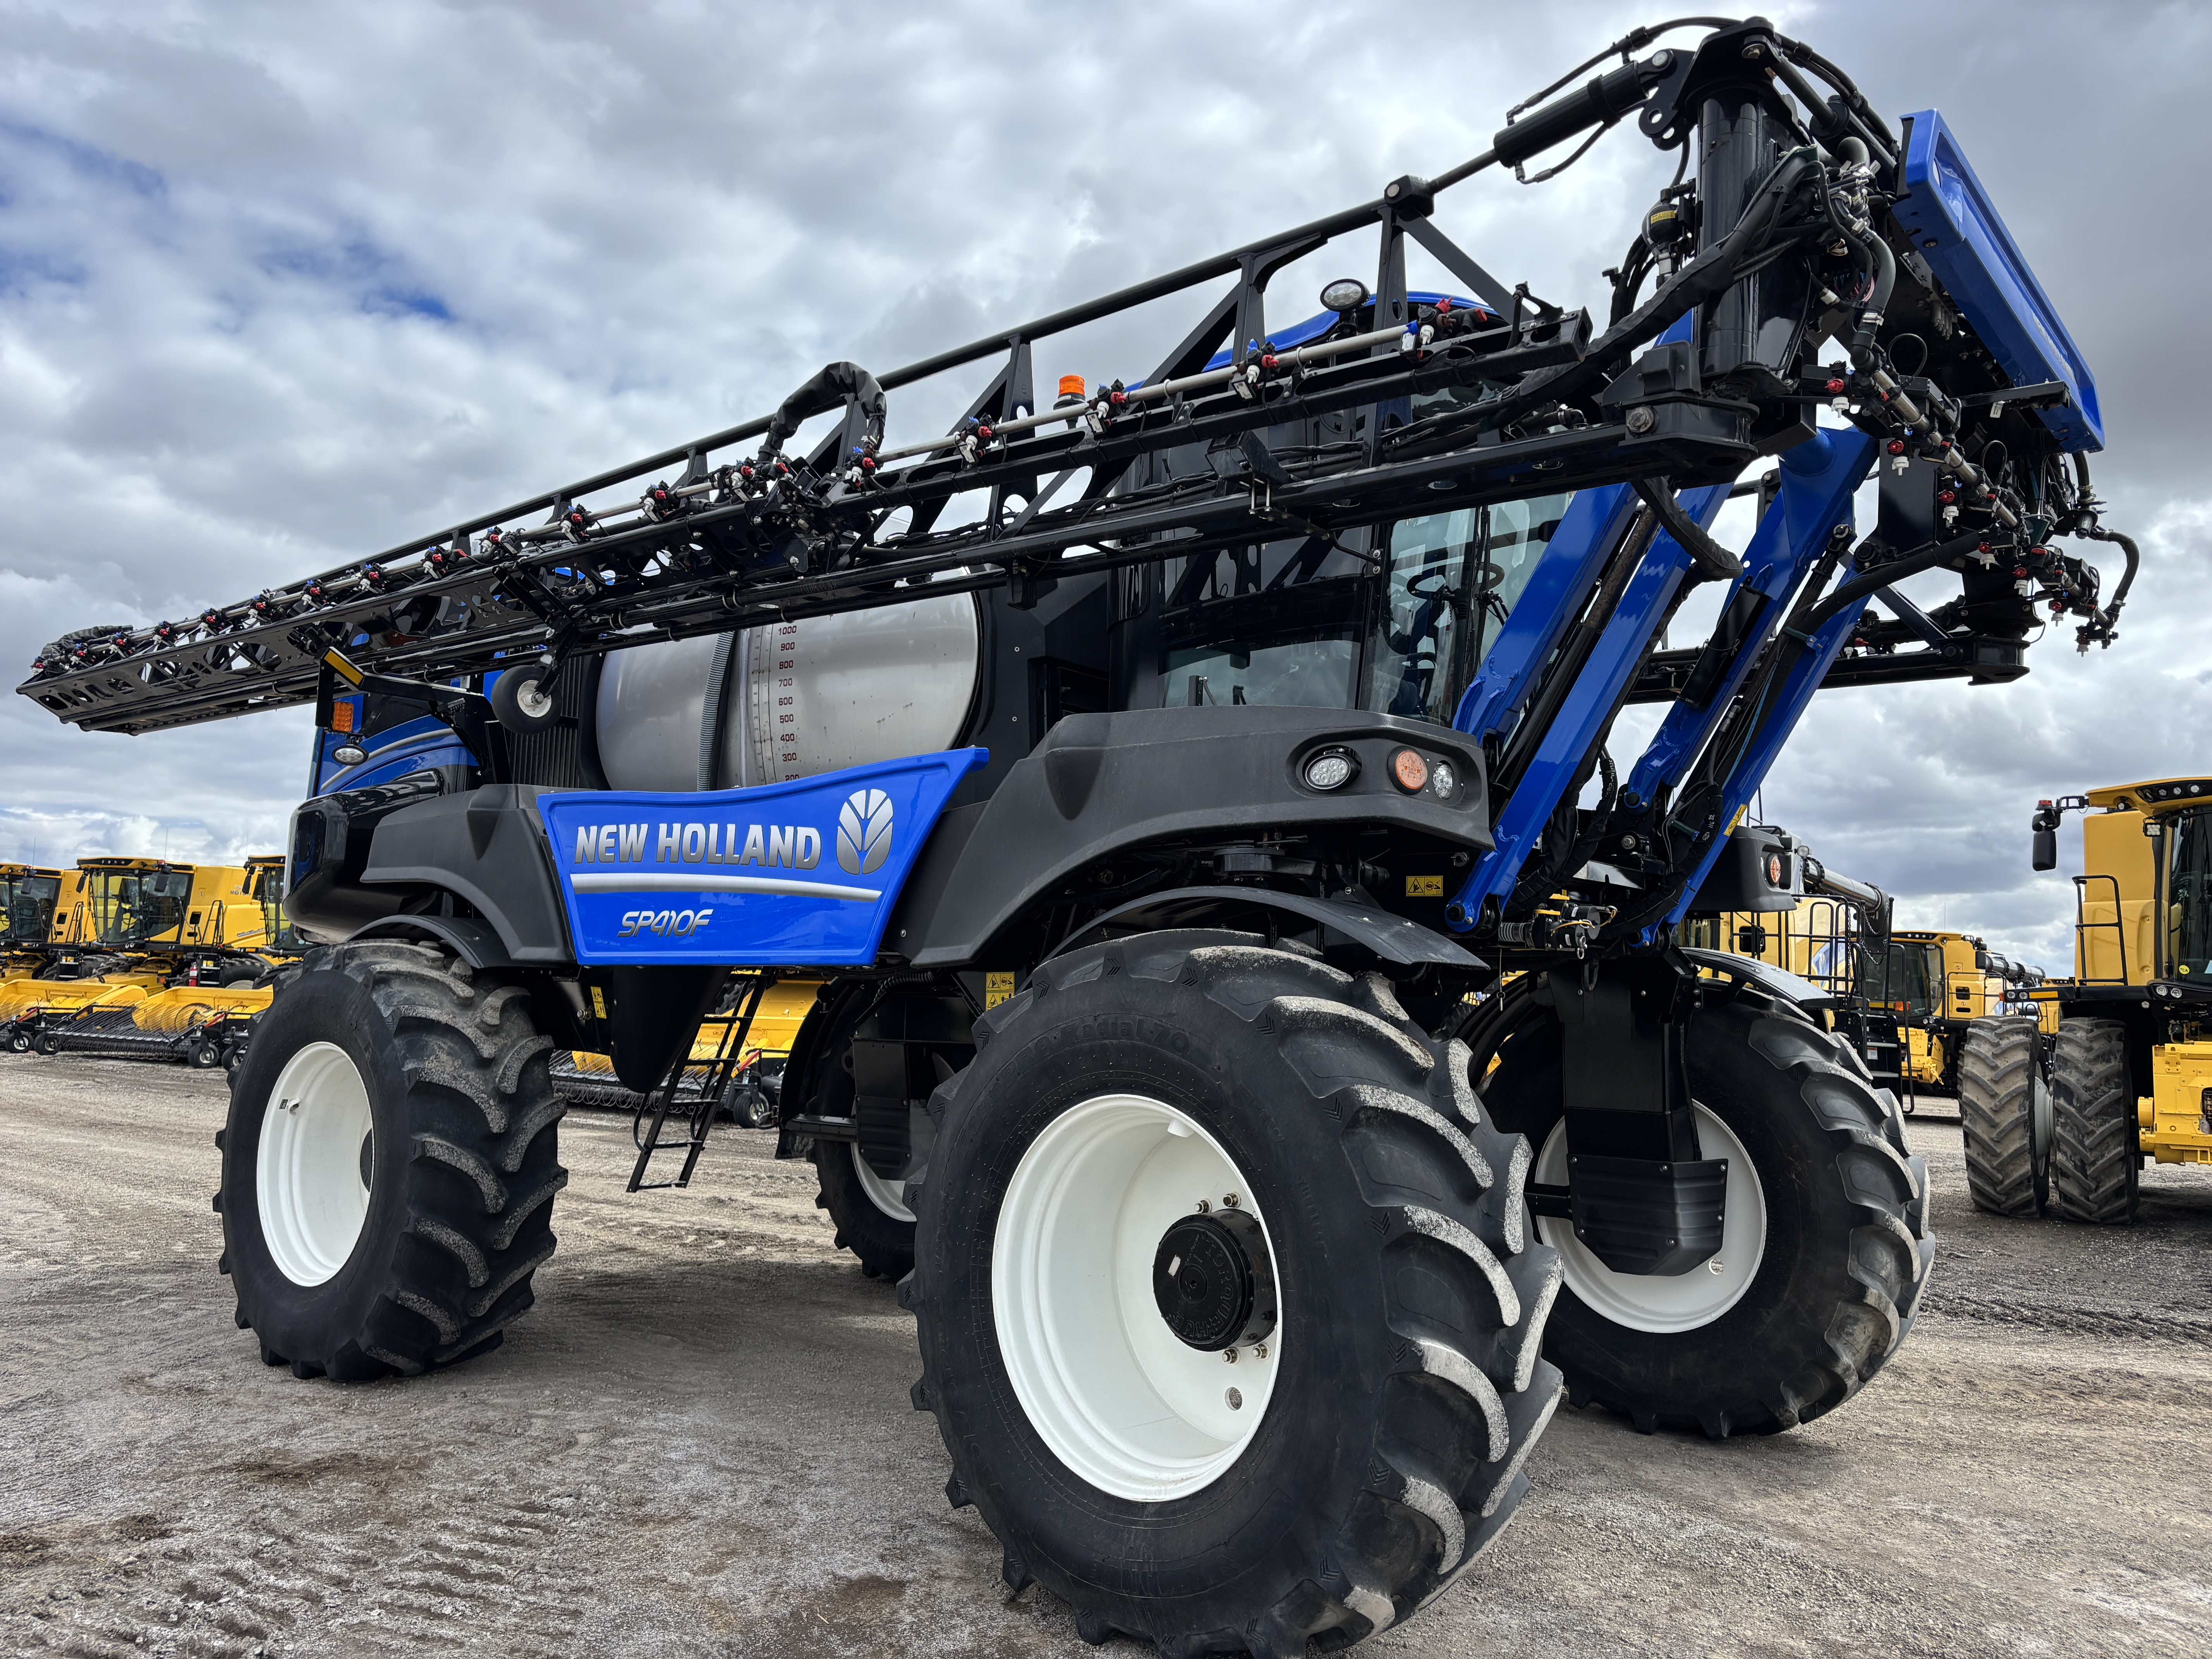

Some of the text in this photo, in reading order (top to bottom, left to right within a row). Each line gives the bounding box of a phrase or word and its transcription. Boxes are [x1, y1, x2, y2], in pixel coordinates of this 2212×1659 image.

[778, 625, 797, 635] 1000
[780, 642, 795, 651] 900
[779, 660, 793, 669] 800
[778, 678, 792, 687] 700
[778, 697, 793, 706] 600
[780, 714, 794, 723] 500
[780, 733, 795, 742] 400
[782, 752, 797, 762] 300
[574, 823, 822, 870] NEW HOLLAND
[617, 908, 714, 938] SP410F
[1059, 1016, 1144, 1046] Radial
[1152, 1021, 1190, 1055] 70
